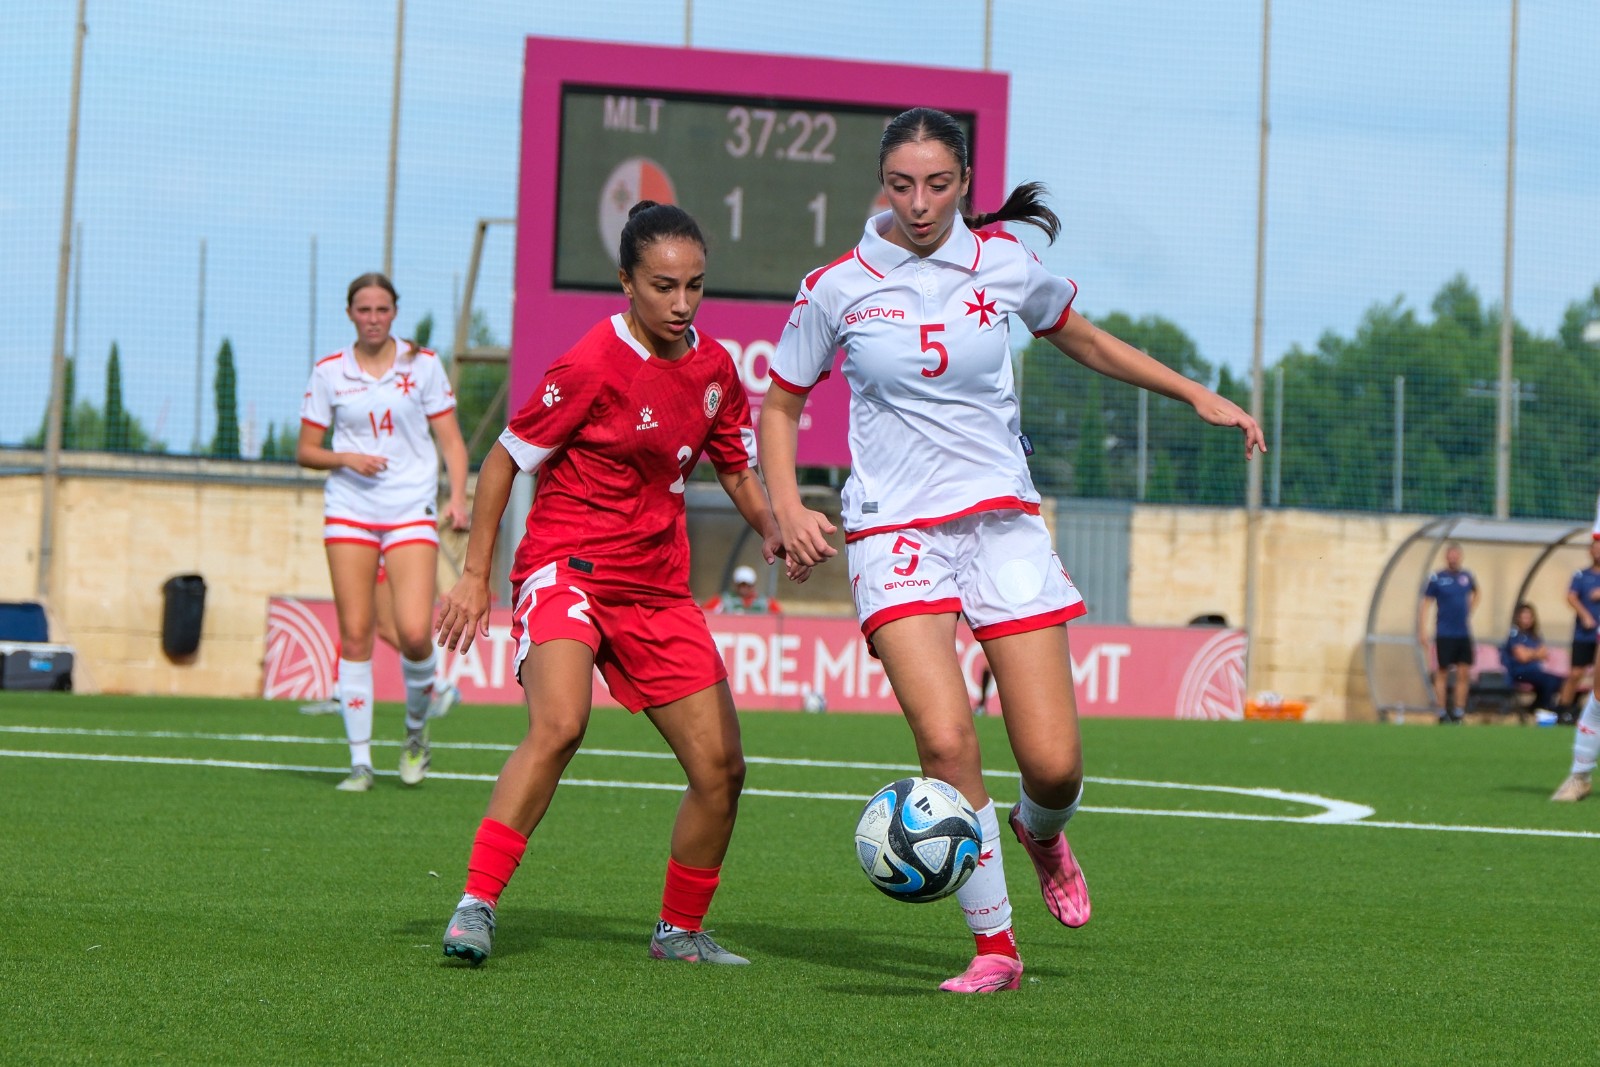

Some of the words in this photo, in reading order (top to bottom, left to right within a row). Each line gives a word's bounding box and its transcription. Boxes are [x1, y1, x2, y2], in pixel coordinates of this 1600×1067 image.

[603, 95, 666, 135] MLT
[725, 105, 837, 163] 37:22
[724, 186, 743, 241] 1
[807, 192, 828, 247] 1
[844, 307, 905, 325] GIVOVA
[919, 323, 949, 378] 5
[368, 408, 395, 439] 14
[636, 421, 659, 431] KELME
[669, 445, 693, 494] 2
[892, 535, 921, 577] 5
[567, 585, 591, 625] 2
[884, 579, 931, 591] GIVOVA
